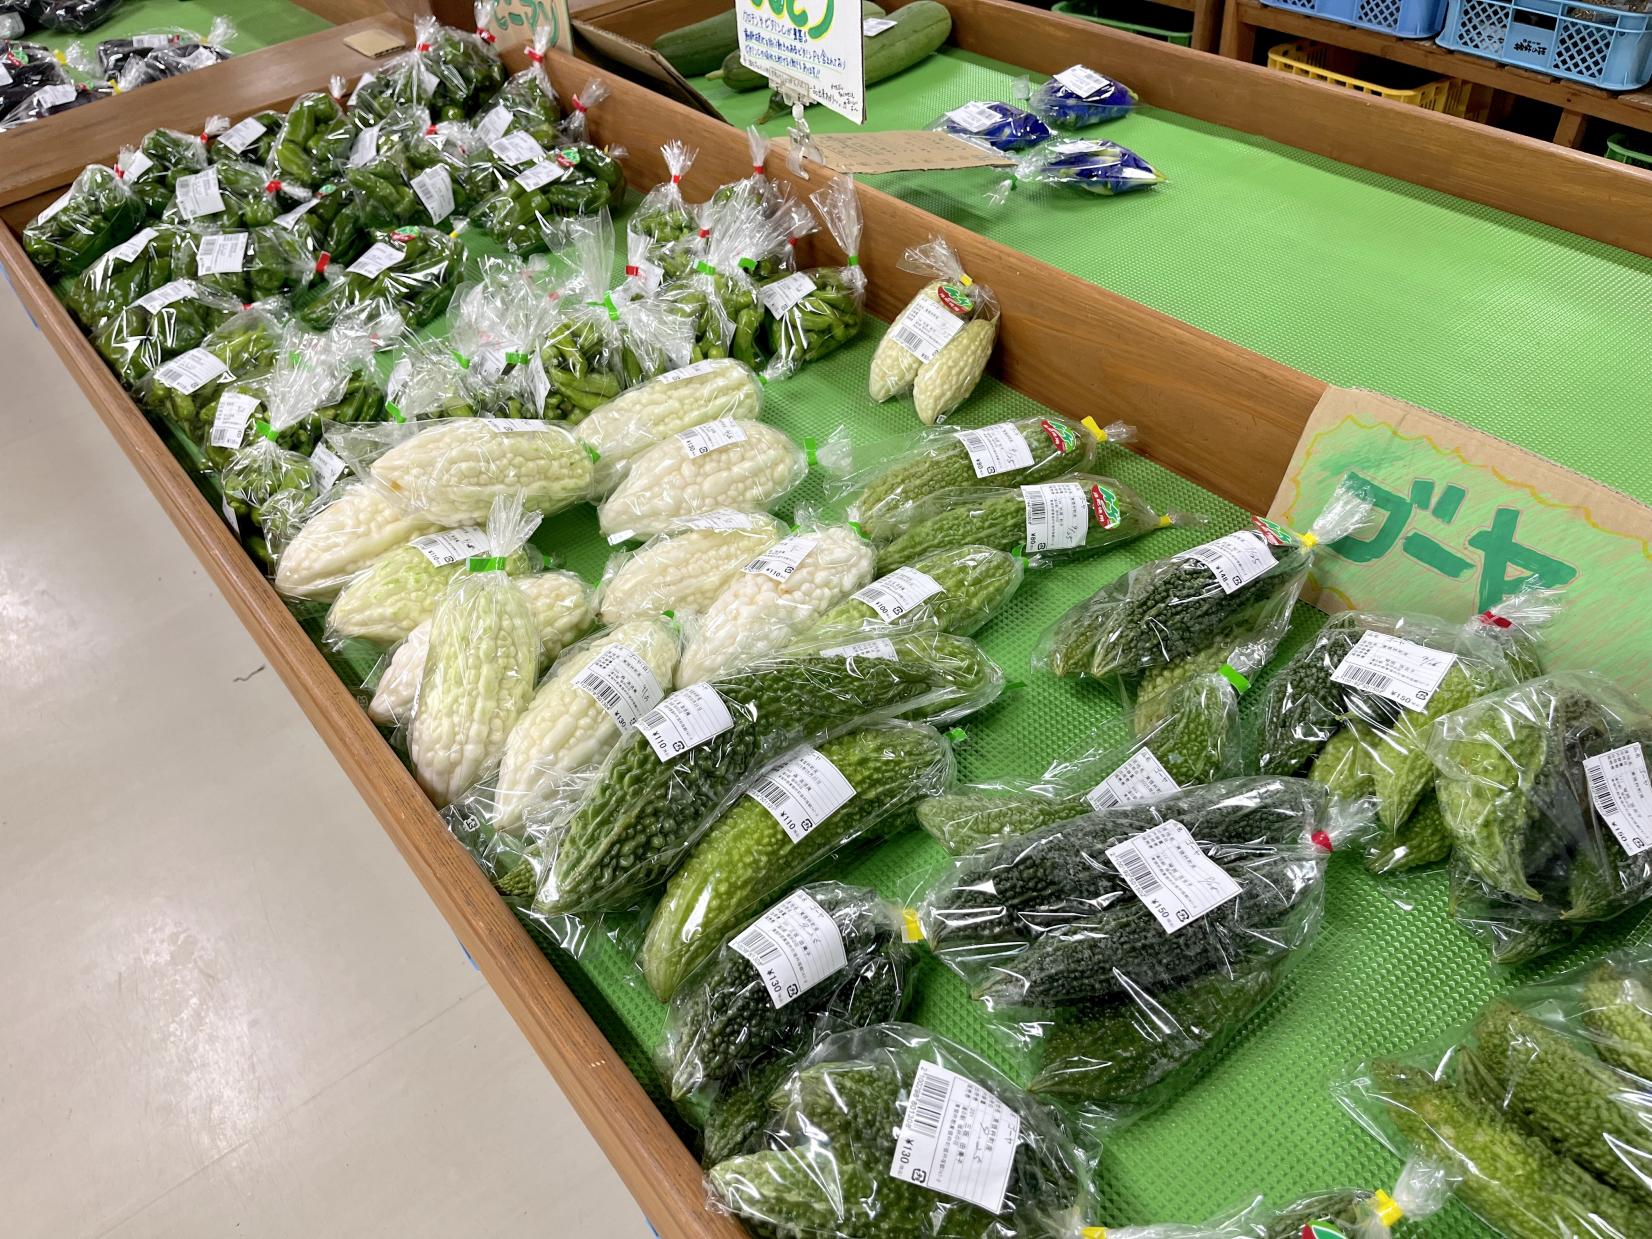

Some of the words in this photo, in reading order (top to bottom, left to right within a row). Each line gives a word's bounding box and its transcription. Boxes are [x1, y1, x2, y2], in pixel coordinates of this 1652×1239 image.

[1328, 472, 1577, 613] ゴーヤ
[1390, 690, 1411, 704] ¥150
[614, 710, 627, 728] ¥130
[652, 730, 667, 749] ¥110
[780, 810, 796, 830] ¥110
[1151, 898, 1170, 918] ¥150
[766, 968, 782, 993] ¥130
[899, 1137, 914, 1164] ¥130
